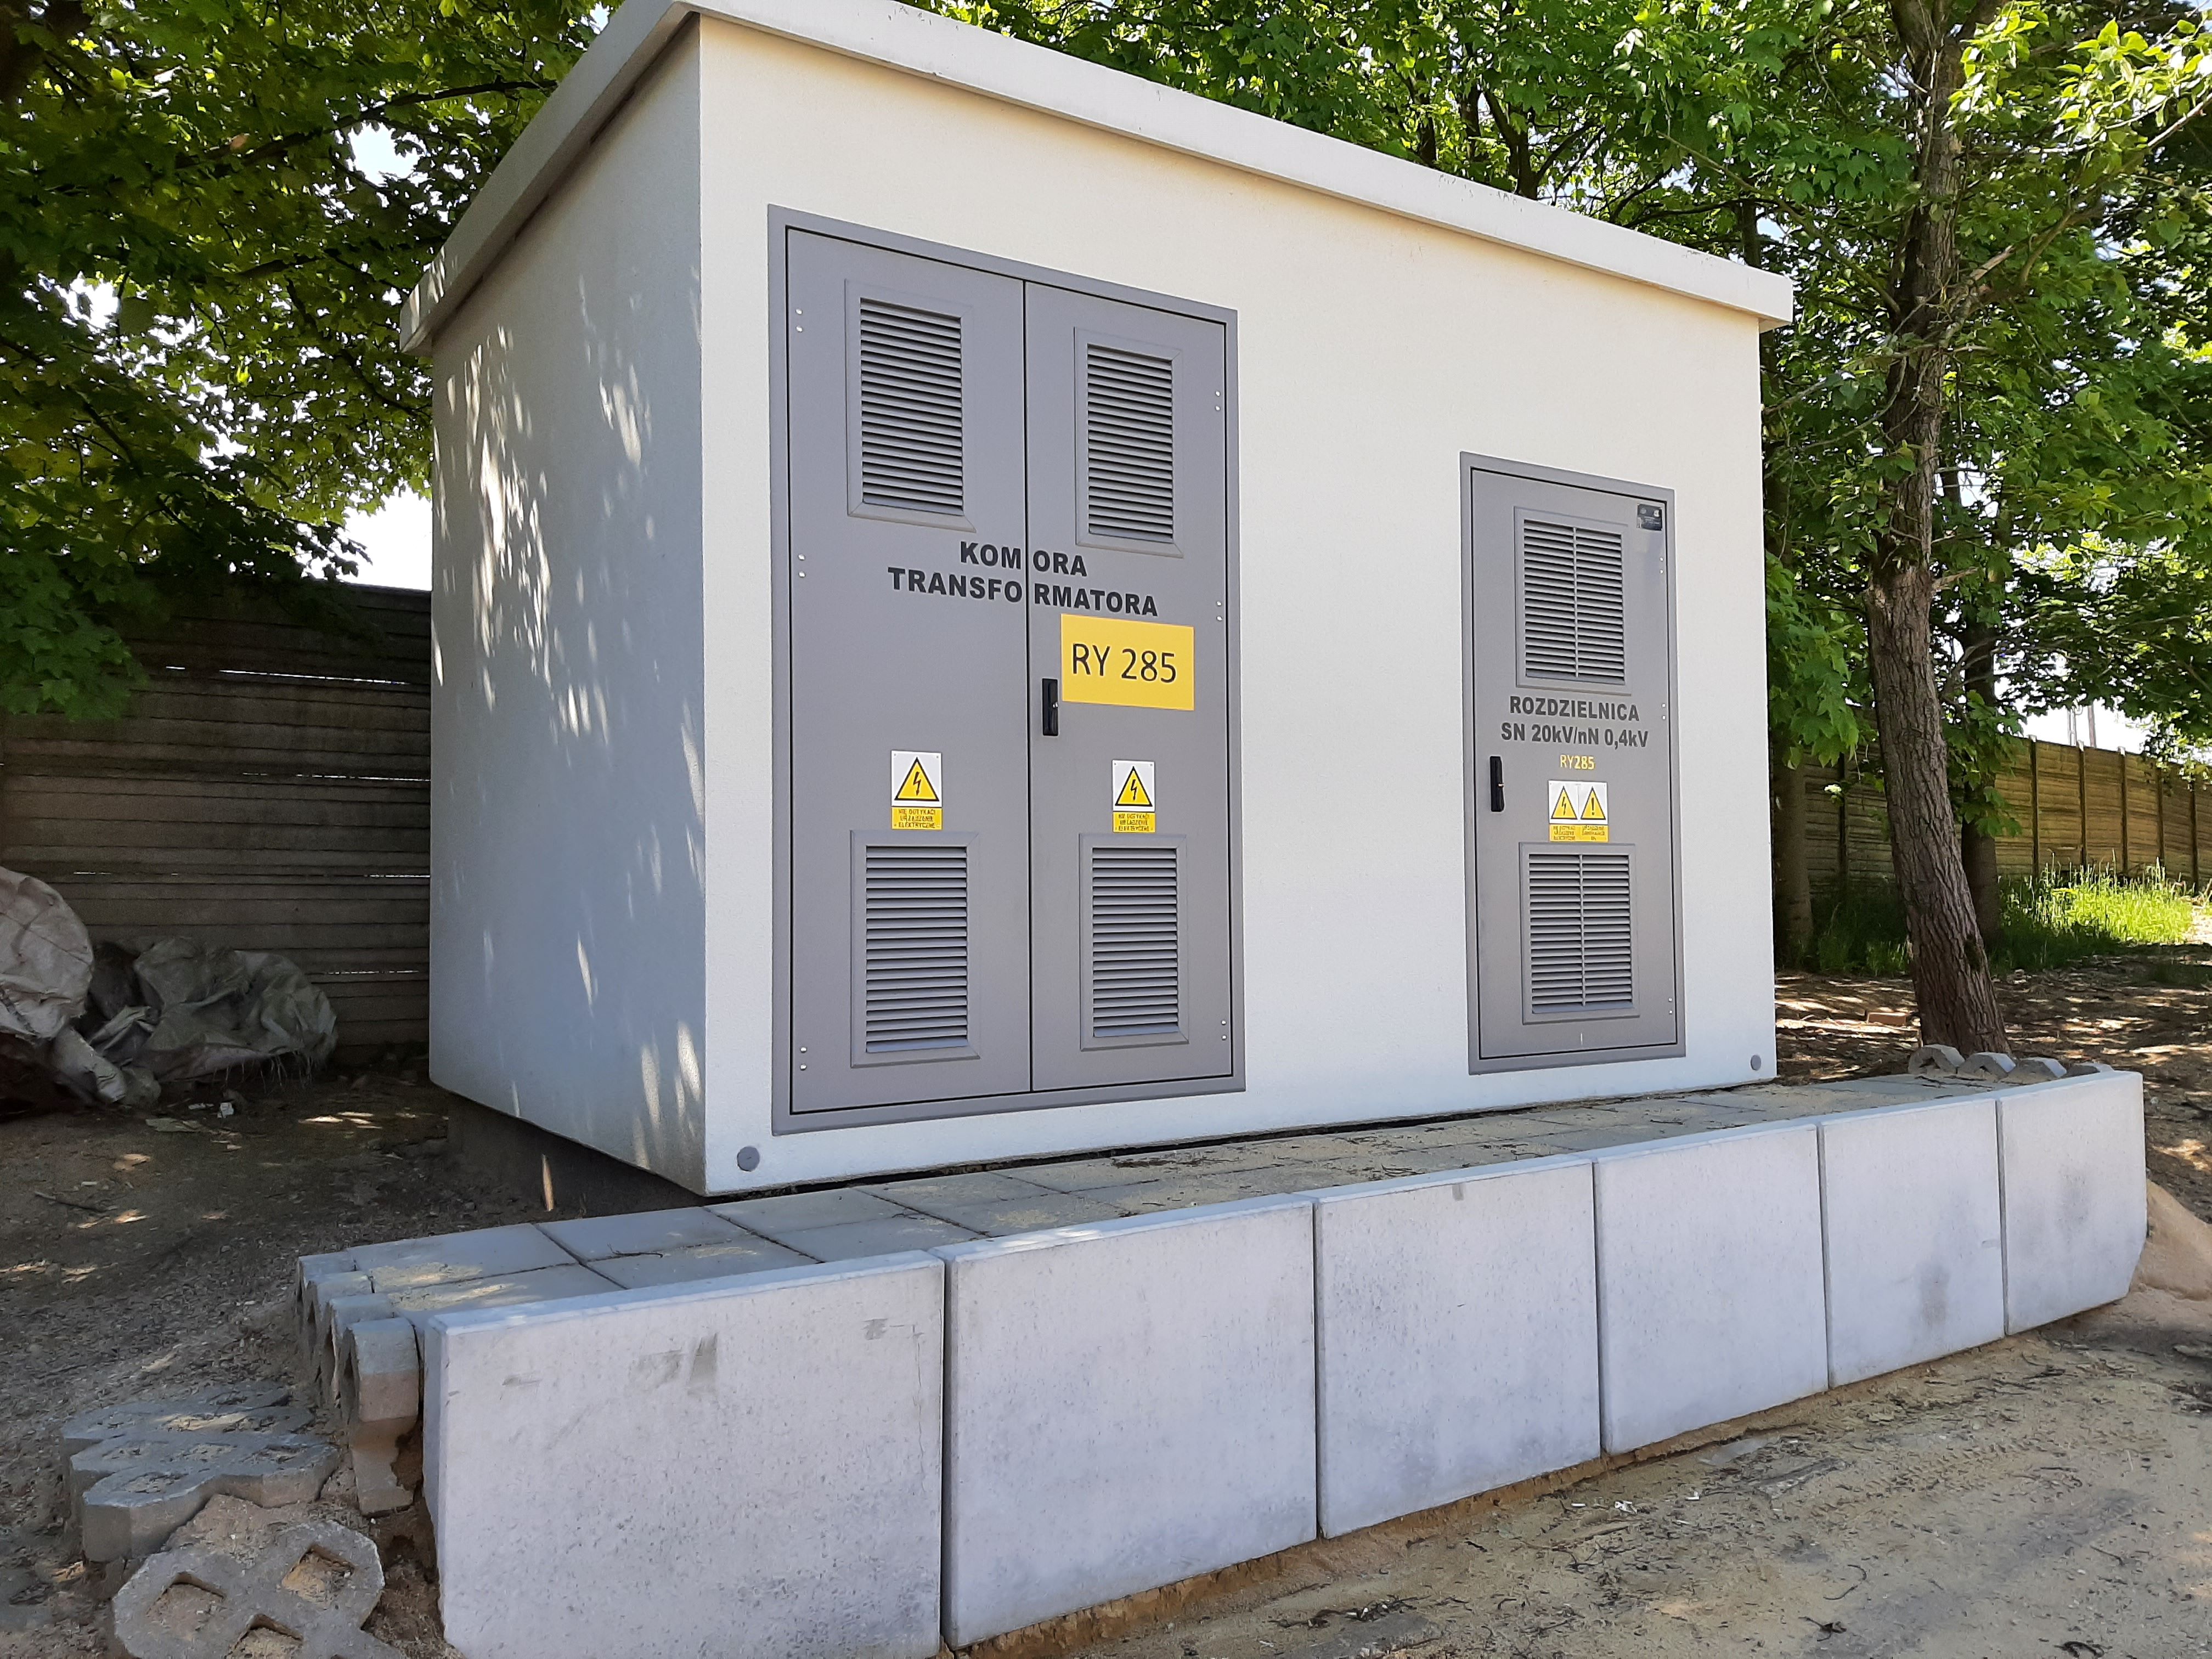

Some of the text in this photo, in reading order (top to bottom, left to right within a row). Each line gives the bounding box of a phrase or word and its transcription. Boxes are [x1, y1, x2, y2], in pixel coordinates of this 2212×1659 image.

[1072, 643, 1177, 683] RY 285
[1510, 696, 1640, 721] ROZDZIELNICA
[1501, 722, 1649, 750] SN 20kV/nN 0,4kV
[1560, 754, 1596, 770] RY285
